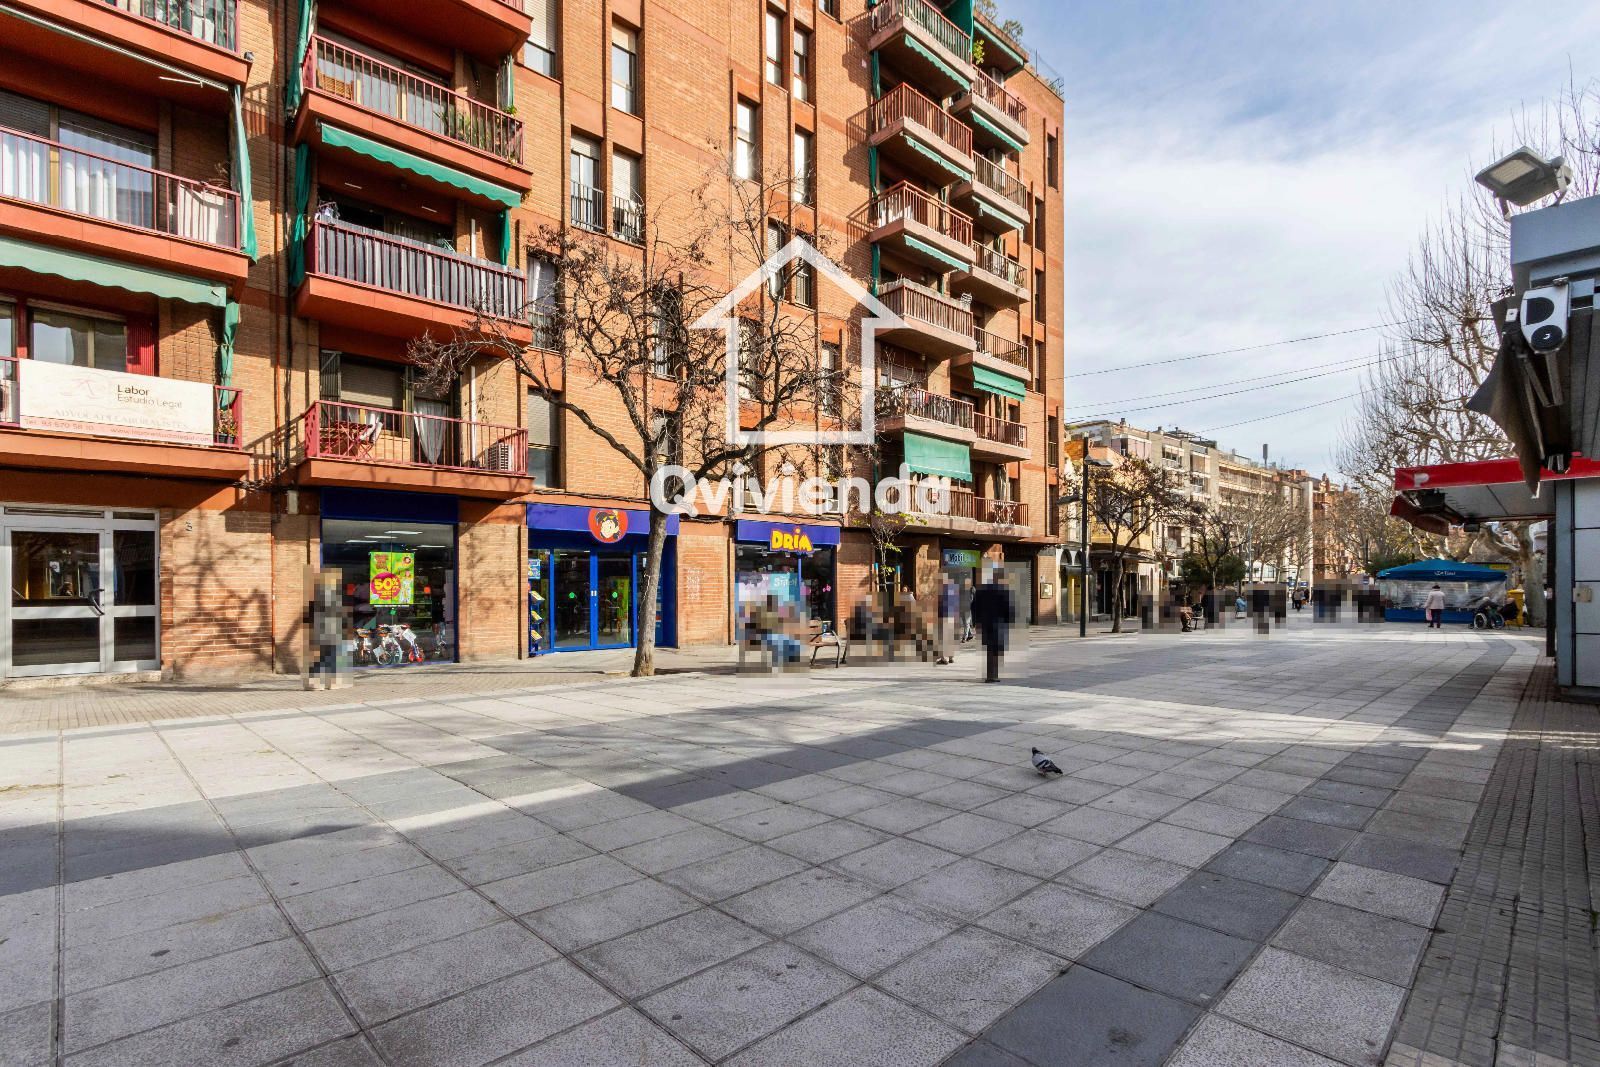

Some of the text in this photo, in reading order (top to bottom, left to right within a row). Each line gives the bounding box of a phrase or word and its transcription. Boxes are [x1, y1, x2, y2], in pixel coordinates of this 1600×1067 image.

[117, 384, 149, 396] Labor
[117, 394, 182, 409] Estudio Legal
